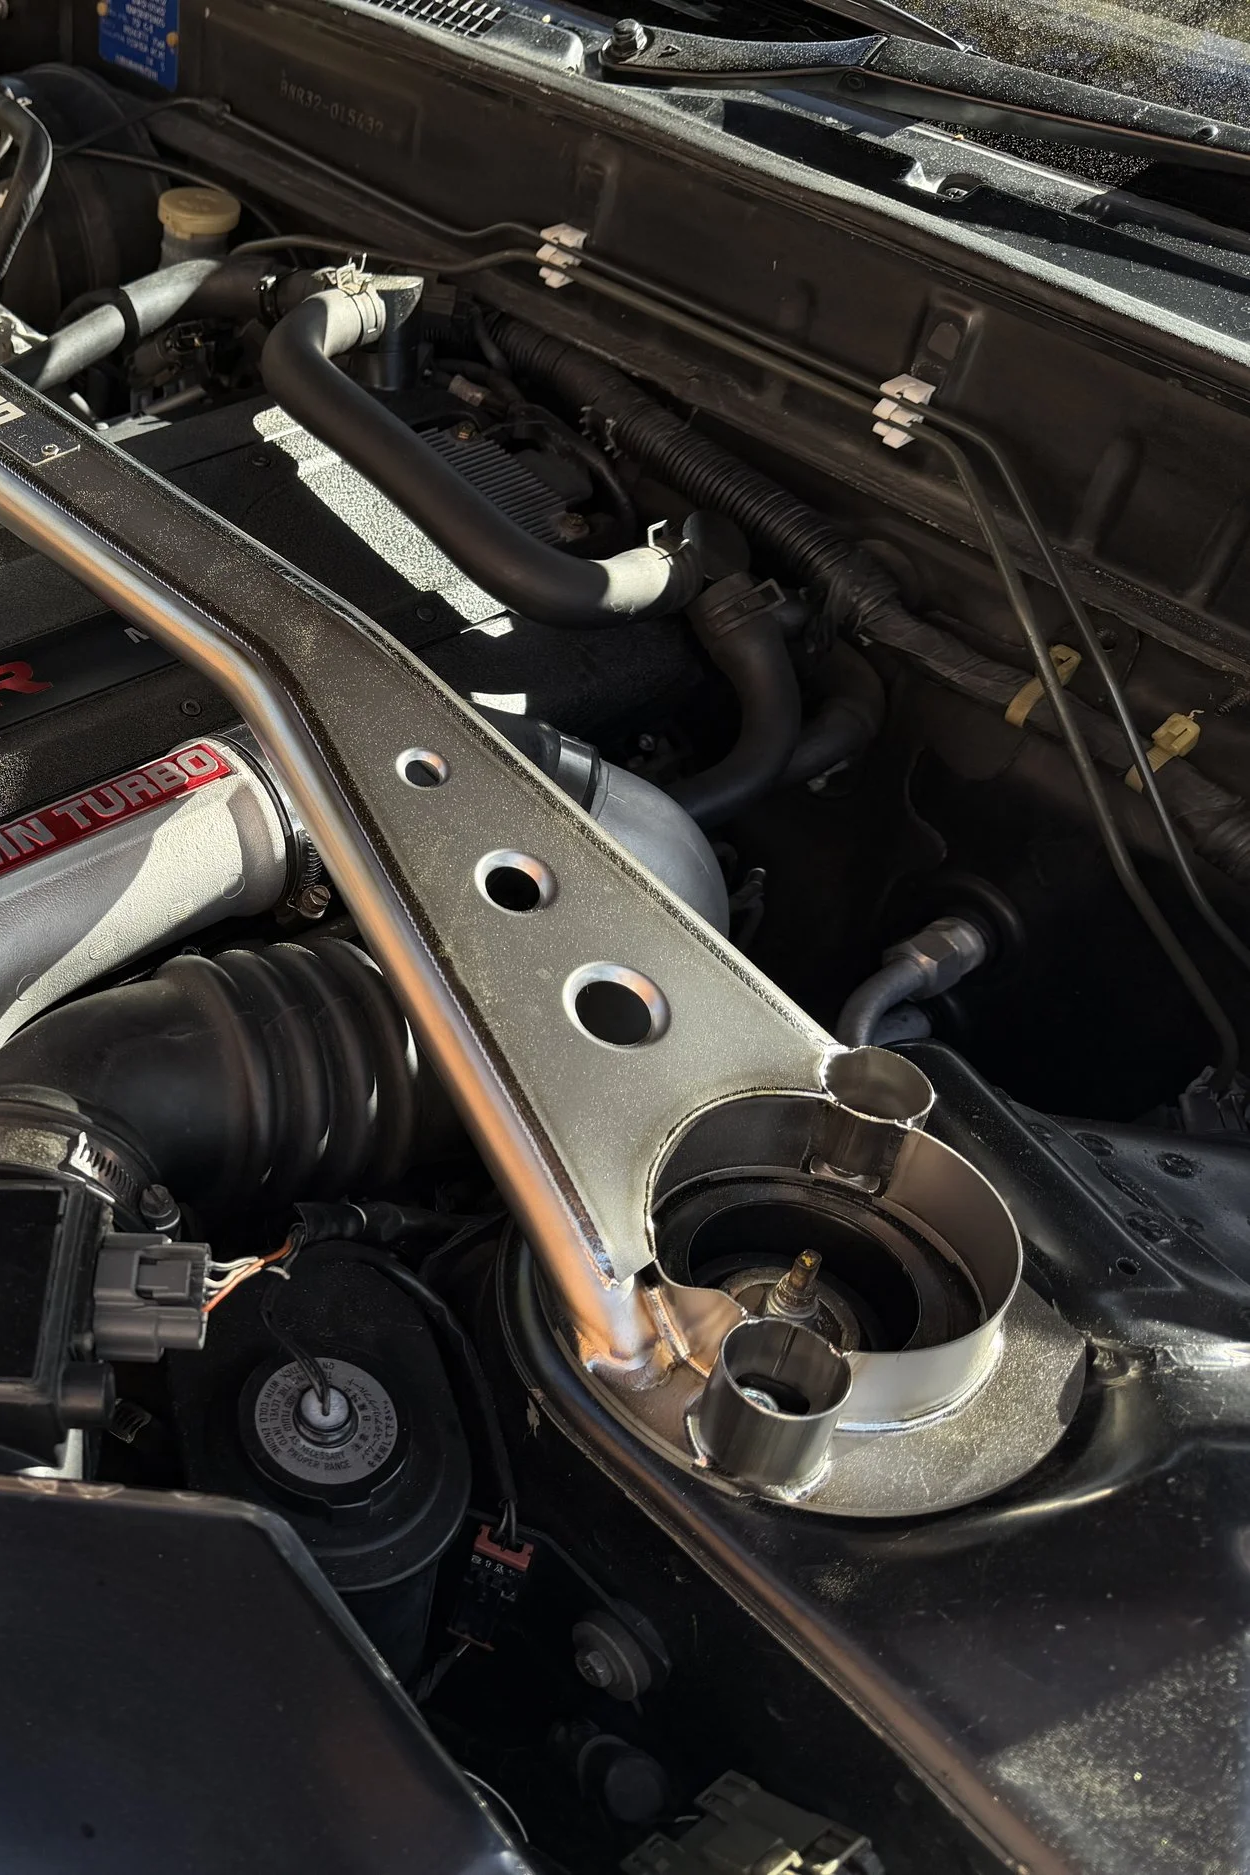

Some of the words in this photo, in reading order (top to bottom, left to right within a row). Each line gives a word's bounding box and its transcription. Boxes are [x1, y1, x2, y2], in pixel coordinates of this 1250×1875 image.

[52, 748, 220, 831] TURBO
[264, 1380, 280, 1399] WITH
[259, 1402, 270, 1423] COLD
[270, 1399, 282, 1421] LEVEL
[272, 1426, 288, 1446] INTO
[289, 1435, 302, 1446] AS
[287, 1447, 321, 1469] PROPER
[324, 1460, 352, 1471] RANGE
